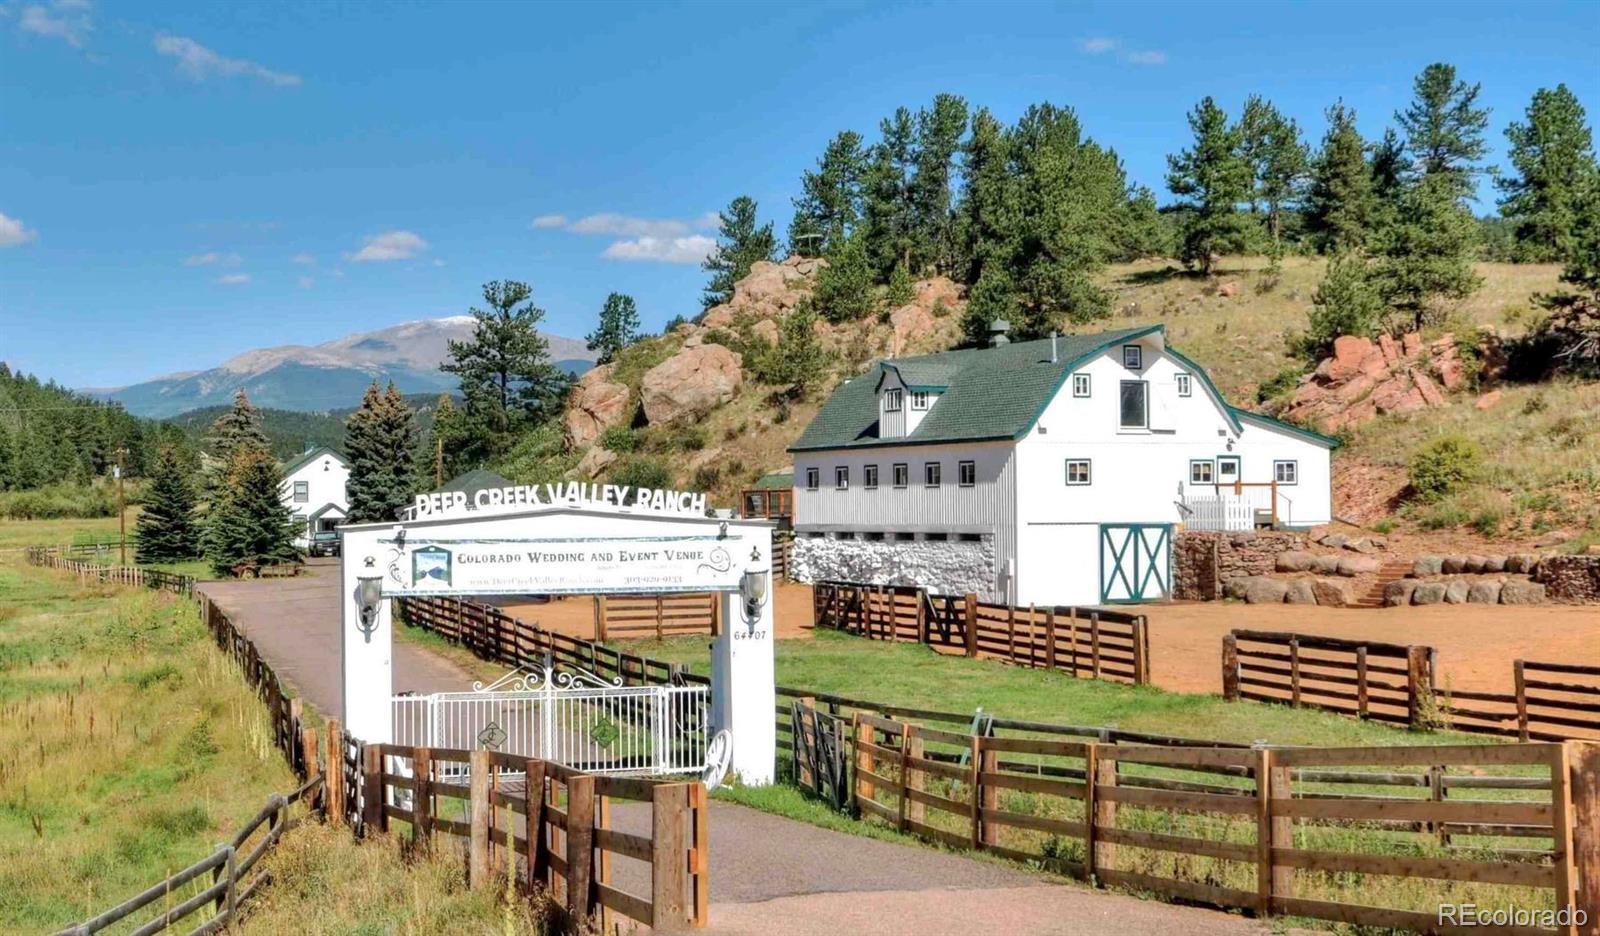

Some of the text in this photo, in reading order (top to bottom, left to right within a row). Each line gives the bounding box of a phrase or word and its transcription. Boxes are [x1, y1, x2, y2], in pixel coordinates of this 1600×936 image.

[415, 481, 706, 520] DEER CREEK VALLEY RANCH
[457, 553, 522, 564] COLORADO
[527, 552, 585, 563] WEDDING
[619, 550, 659, 562] EVENT
[663, 550, 704, 561] VENUE
